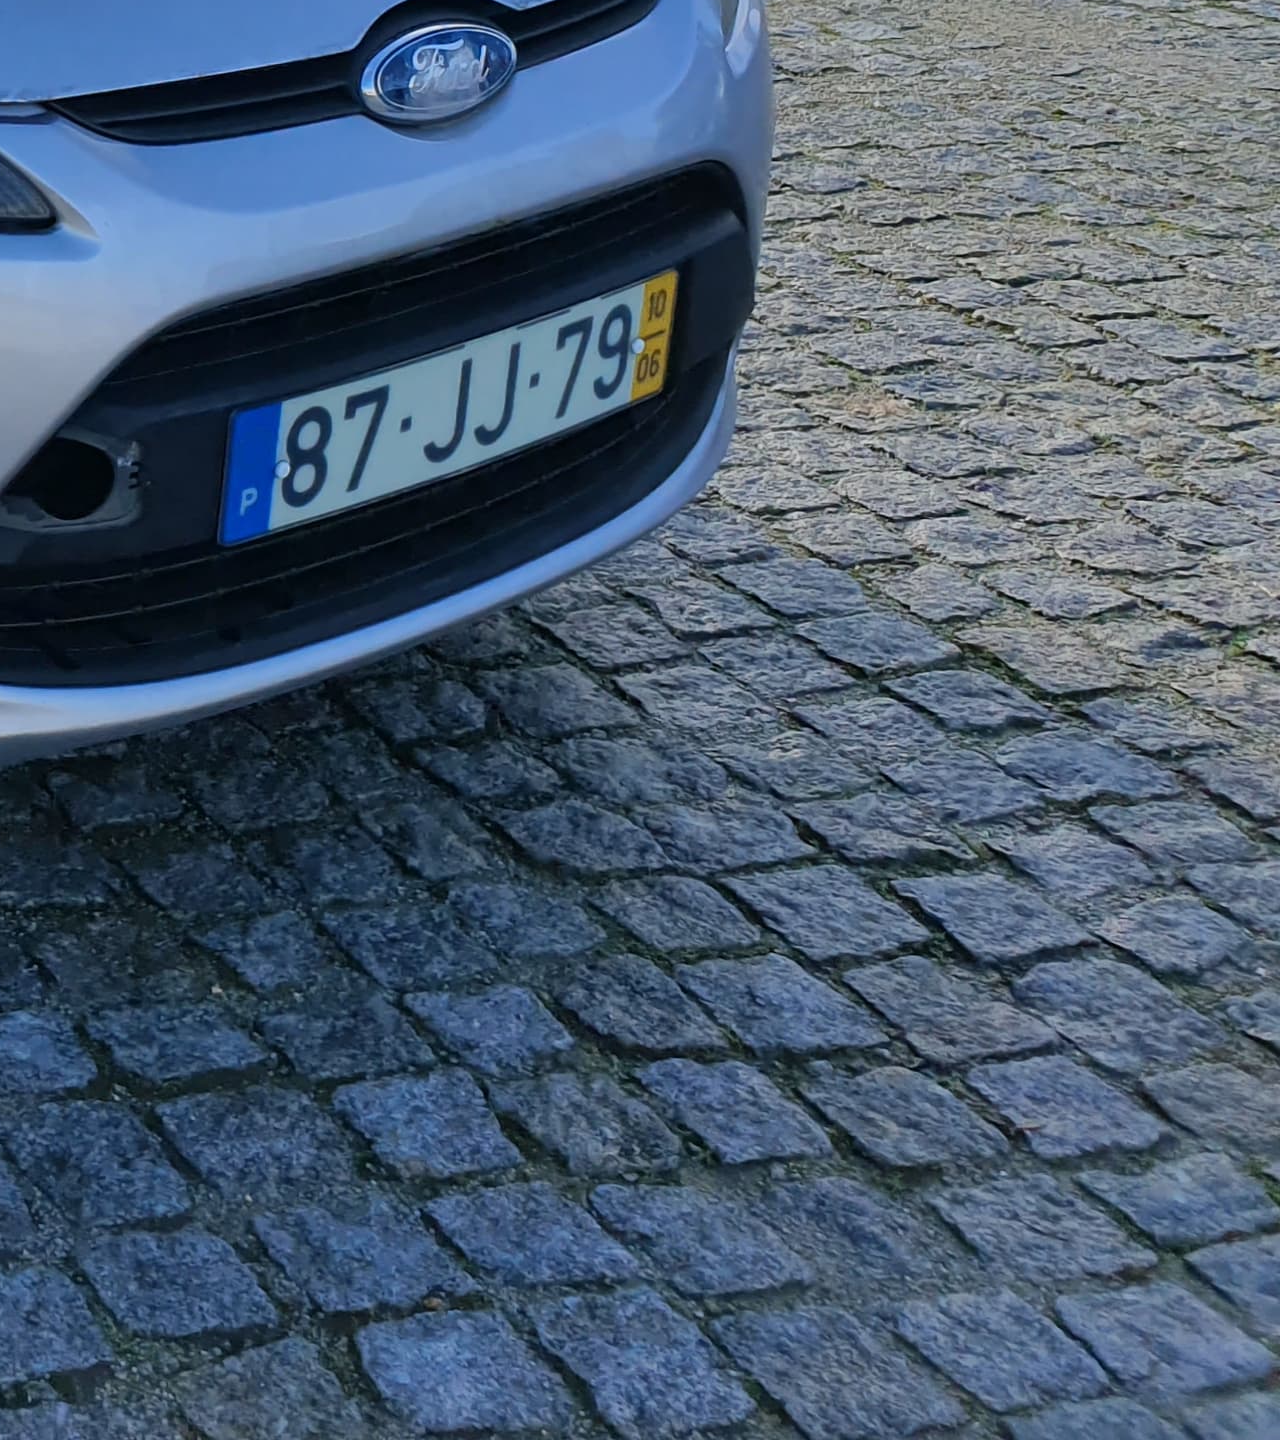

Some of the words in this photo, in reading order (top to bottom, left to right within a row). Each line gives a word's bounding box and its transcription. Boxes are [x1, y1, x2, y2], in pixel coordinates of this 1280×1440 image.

[647, 289, 668, 322] 10
[636, 348, 662, 383] 06
[239, 486, 259, 517] P
